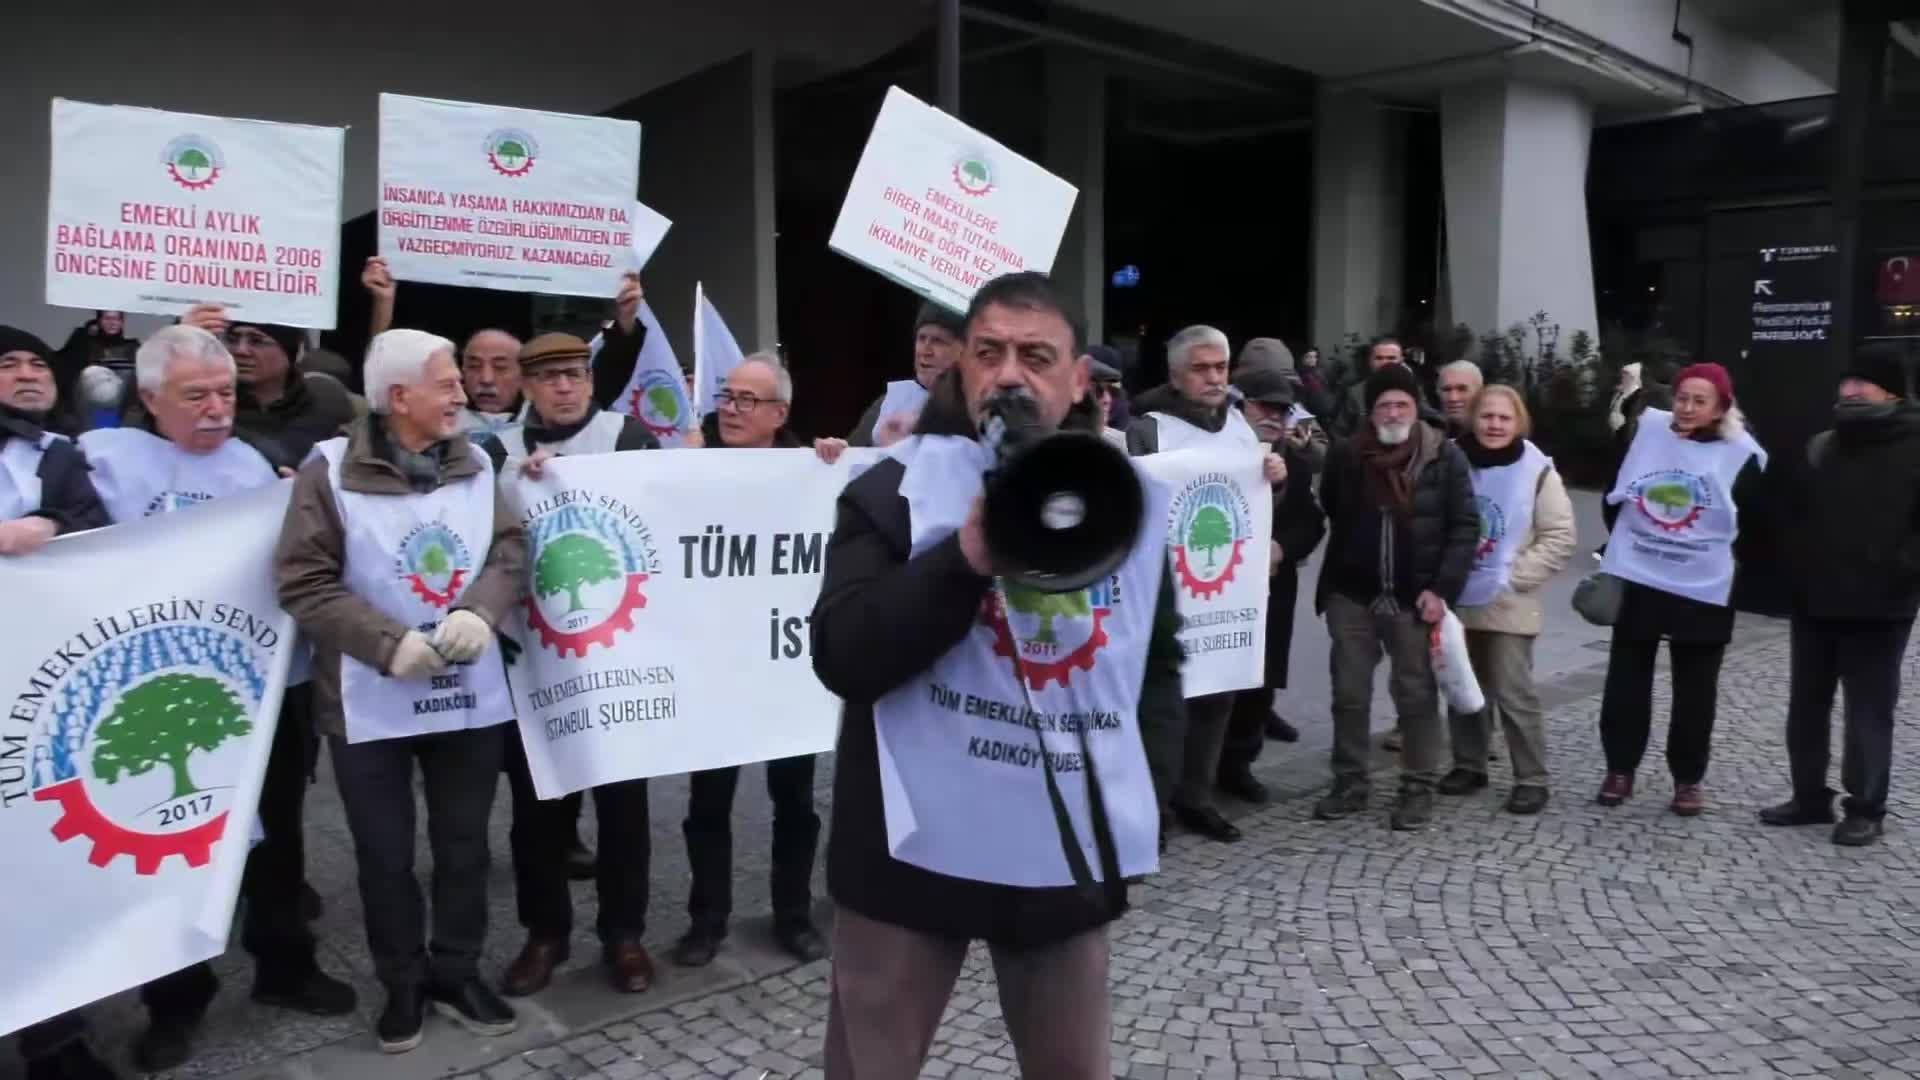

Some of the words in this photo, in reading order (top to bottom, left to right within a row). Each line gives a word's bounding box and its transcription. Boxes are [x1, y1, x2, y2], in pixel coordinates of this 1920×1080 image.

[121, 202, 196, 229] EMEKLİ
[205, 210, 260, 234] AYLIK
[383, 183, 446, 206] İNSANCA
[451, 193, 508, 214] YAŞAMA
[513, 199, 604, 222] HAKKIMIZDAN
[58, 223, 155, 253] BAĞLAMA
[165, 235, 267, 264] ORANINDA
[614, 232, 632, 247] DE
[55, 248, 156, 281] ÖNCESİNE
[165, 260, 322, 296] DÖNÜLMELİDİR.
[973, 254, 996, 276] KEZ
[678, 524, 756, 579] TÜM
[9, 595, 204, 723] EMEKLİLERİN
[929, 684, 961, 713] TÜM
[968, 736, 1040, 768] KADIKÖY
[158, 794, 214, 826] 2017
